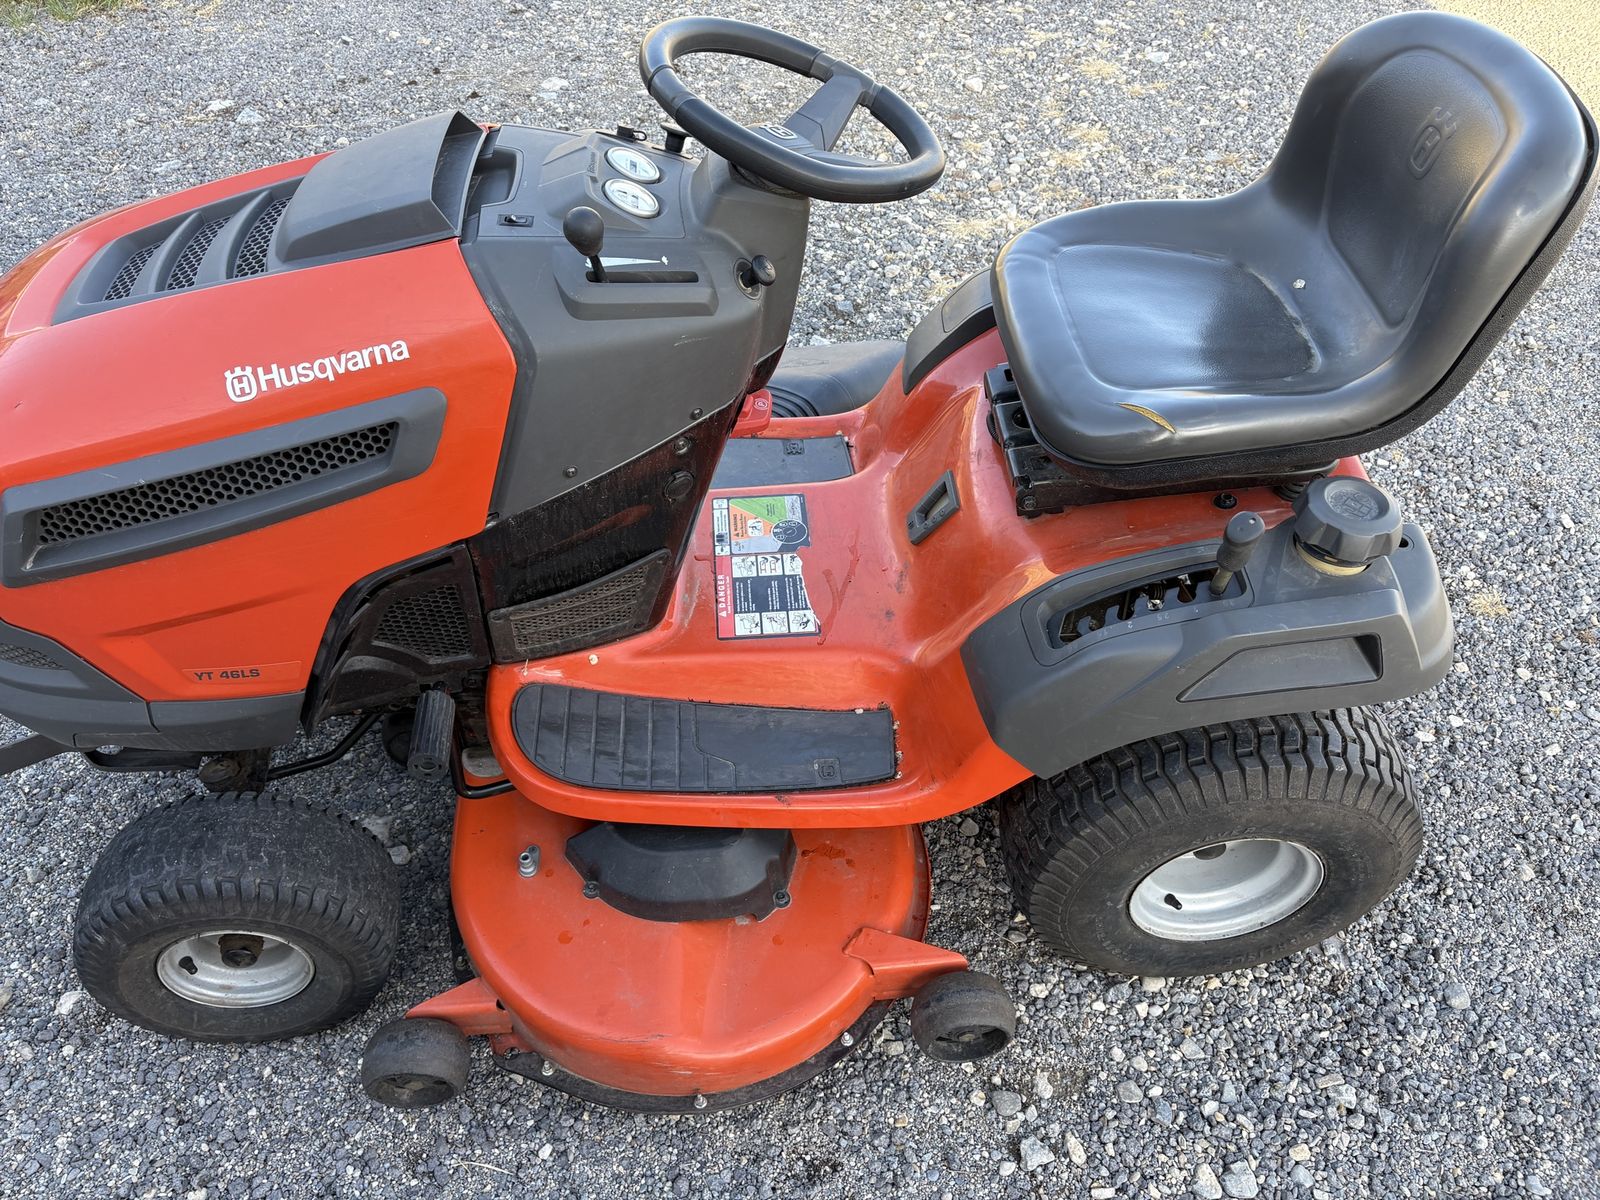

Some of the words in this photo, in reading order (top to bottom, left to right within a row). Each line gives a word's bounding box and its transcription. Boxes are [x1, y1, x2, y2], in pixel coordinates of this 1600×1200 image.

[257, 339, 410, 392] Husqvarna
[717, 574, 727, 608] DANGER
[193, 671, 214, 681] YT
[219, 668, 260, 680] 46LS
